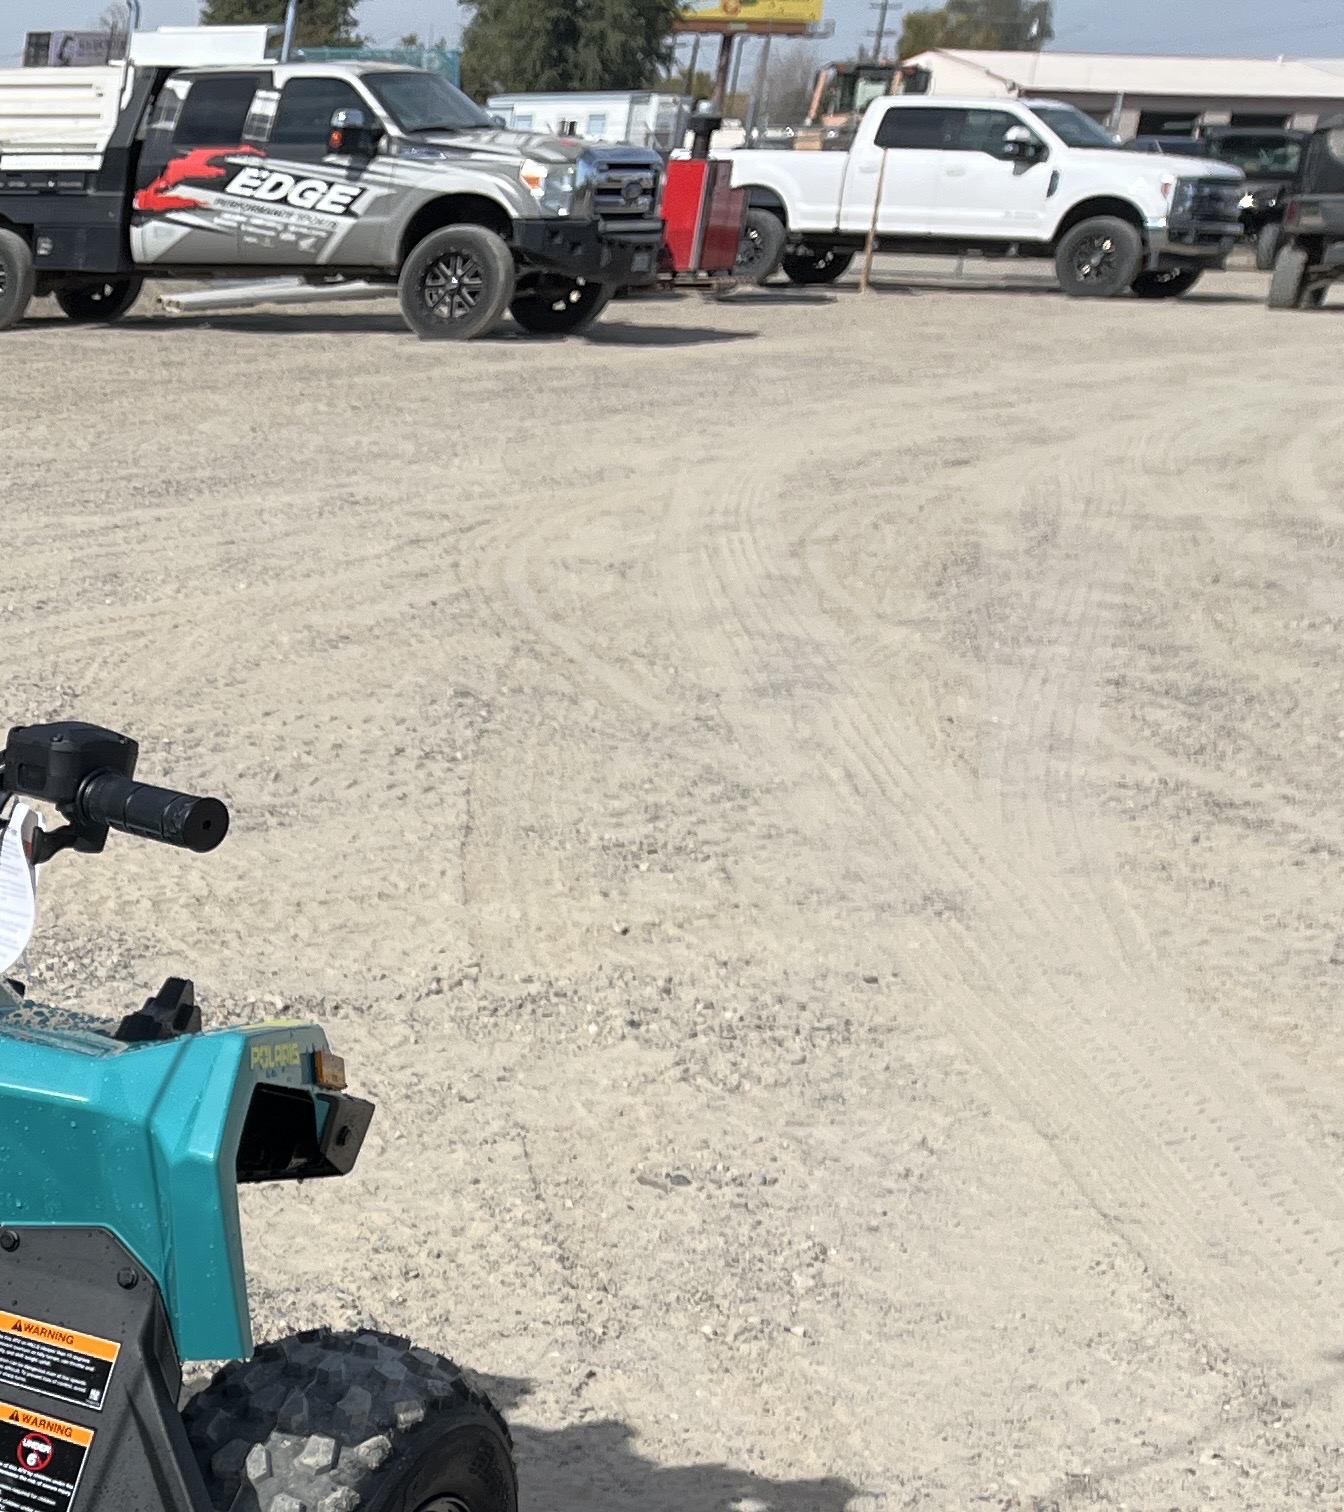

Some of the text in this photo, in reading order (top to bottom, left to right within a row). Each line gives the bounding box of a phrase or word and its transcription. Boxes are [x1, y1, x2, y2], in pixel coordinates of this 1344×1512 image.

[225, 166, 362, 214] EDGE
[250, 1042, 301, 1070] POLARIS
[23, 1322, 74, 1345] WARNING
[22, 1414, 72, 1437] WARNING
